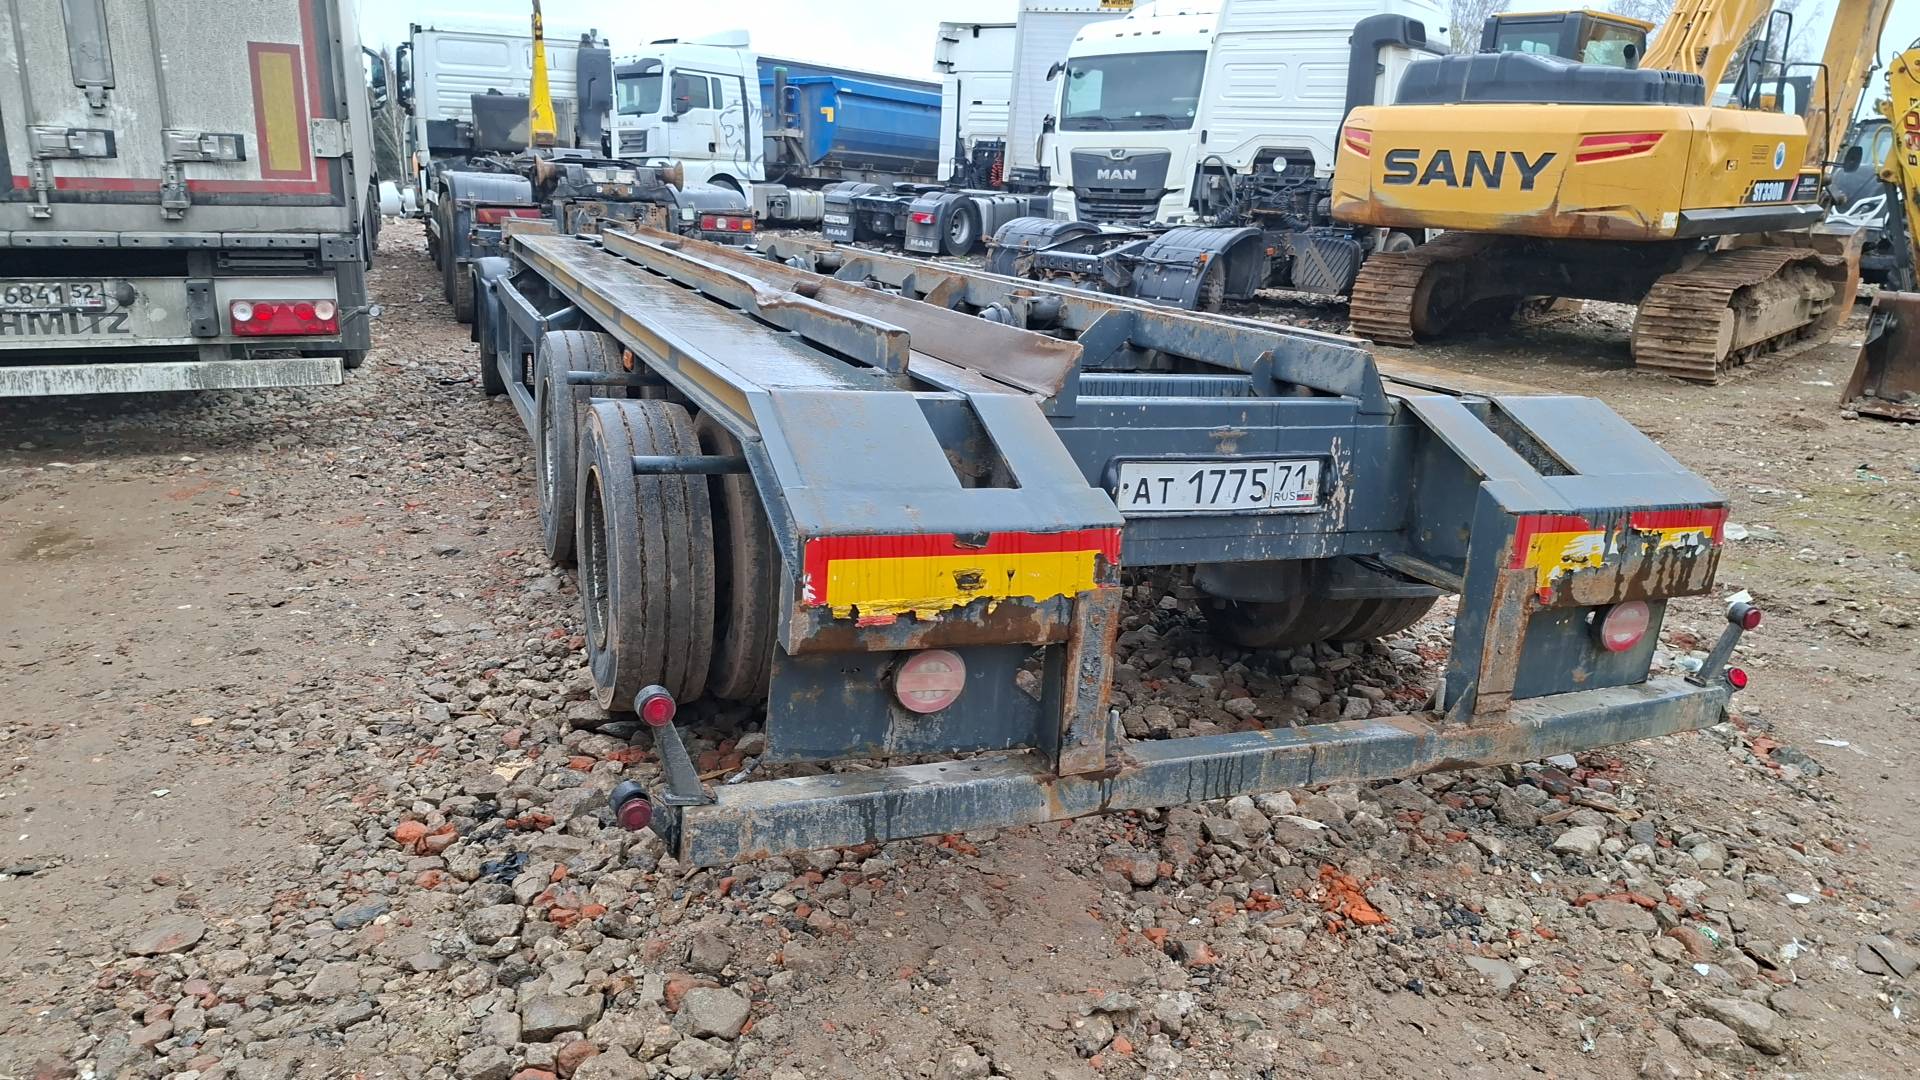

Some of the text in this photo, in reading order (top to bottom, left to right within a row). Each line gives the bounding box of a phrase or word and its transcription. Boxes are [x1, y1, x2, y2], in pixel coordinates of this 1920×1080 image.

[1097, 169, 1137, 180] MAN
[1383, 149, 1557, 191] SANY
[826, 228, 848, 237] MAN
[910, 239, 934, 248] MAN
[4, 284, 94, 305] 6841 52
[1133, 464, 1308, 505] AT 1775 71
[1273, 491, 1296, 502] RUS
